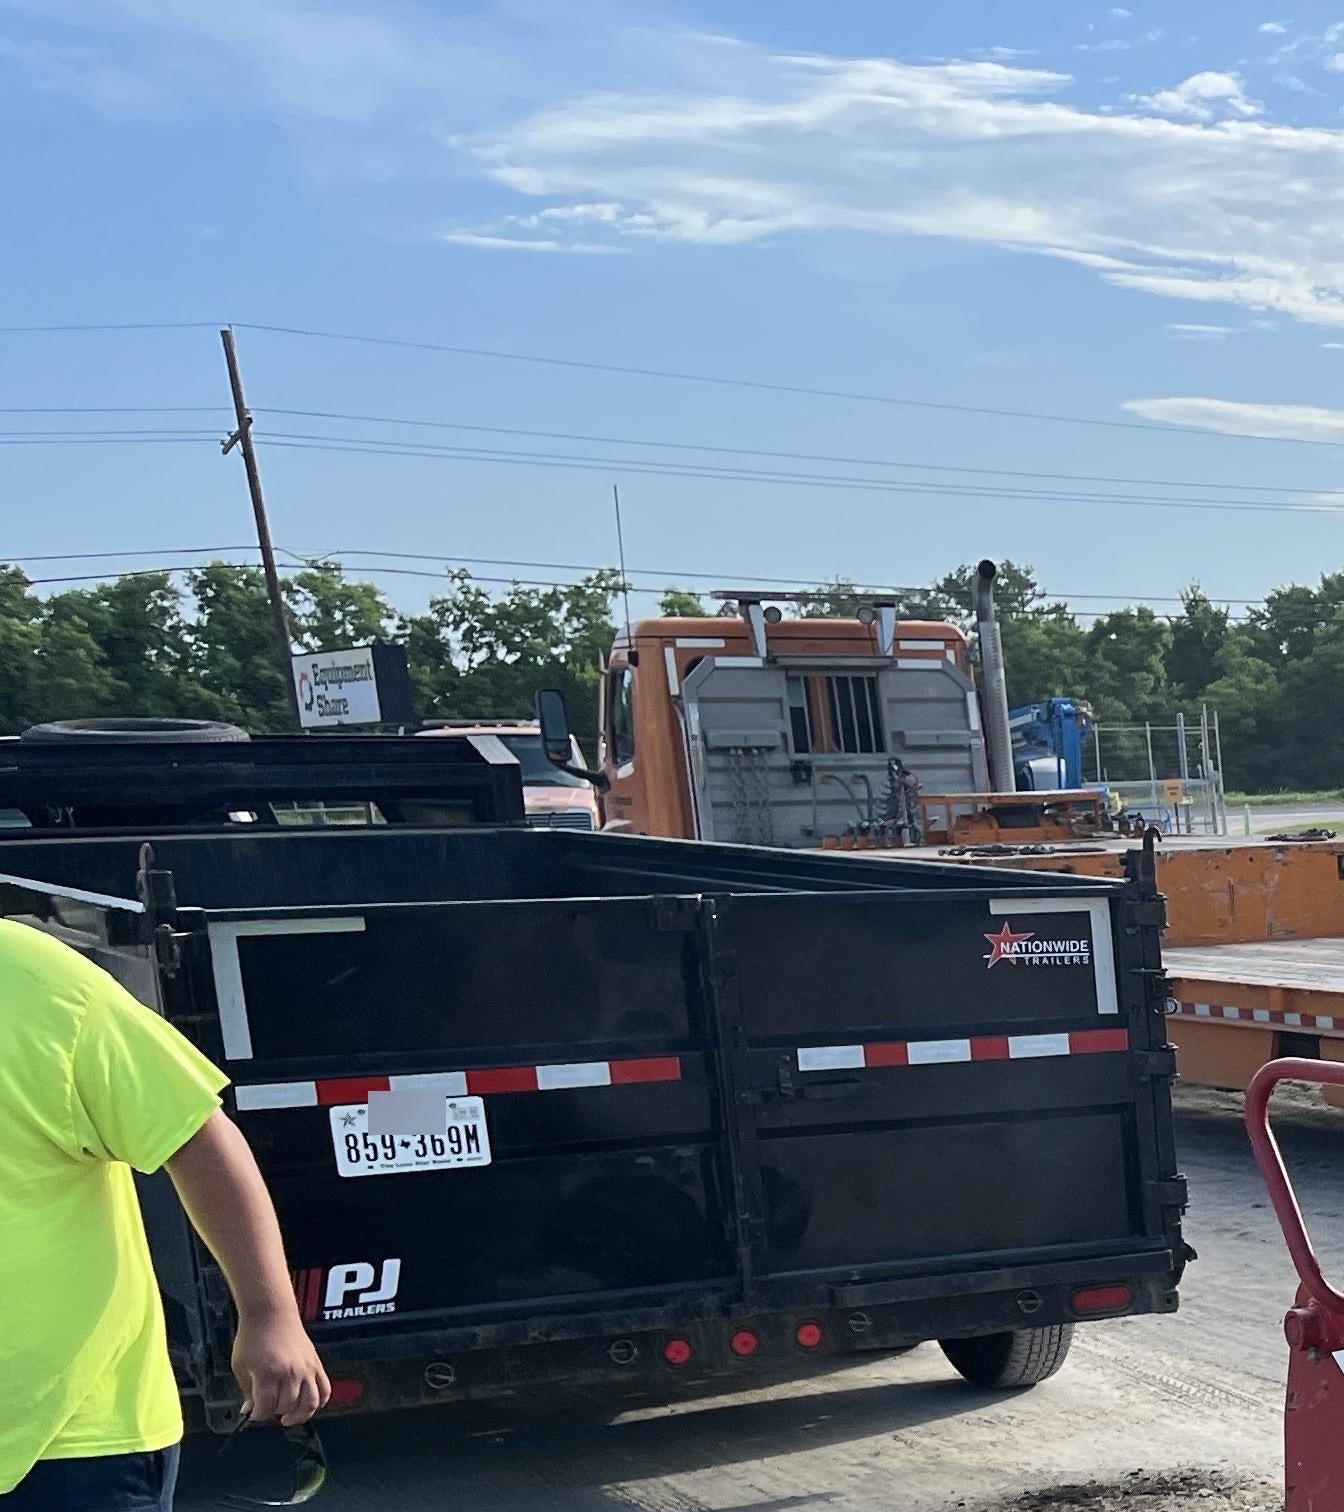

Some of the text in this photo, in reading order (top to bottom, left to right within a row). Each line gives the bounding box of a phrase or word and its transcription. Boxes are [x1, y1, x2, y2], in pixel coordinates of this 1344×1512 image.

[311, 659, 373, 691] Equipment
[316, 694, 350, 718] Share
[1000, 939, 1090, 954] NATIONWIDE
[1024, 956, 1090, 966] TRAILERS
[324, 1258, 402, 1307] PJ
[322, 1302, 396, 1321] TRAILERS
